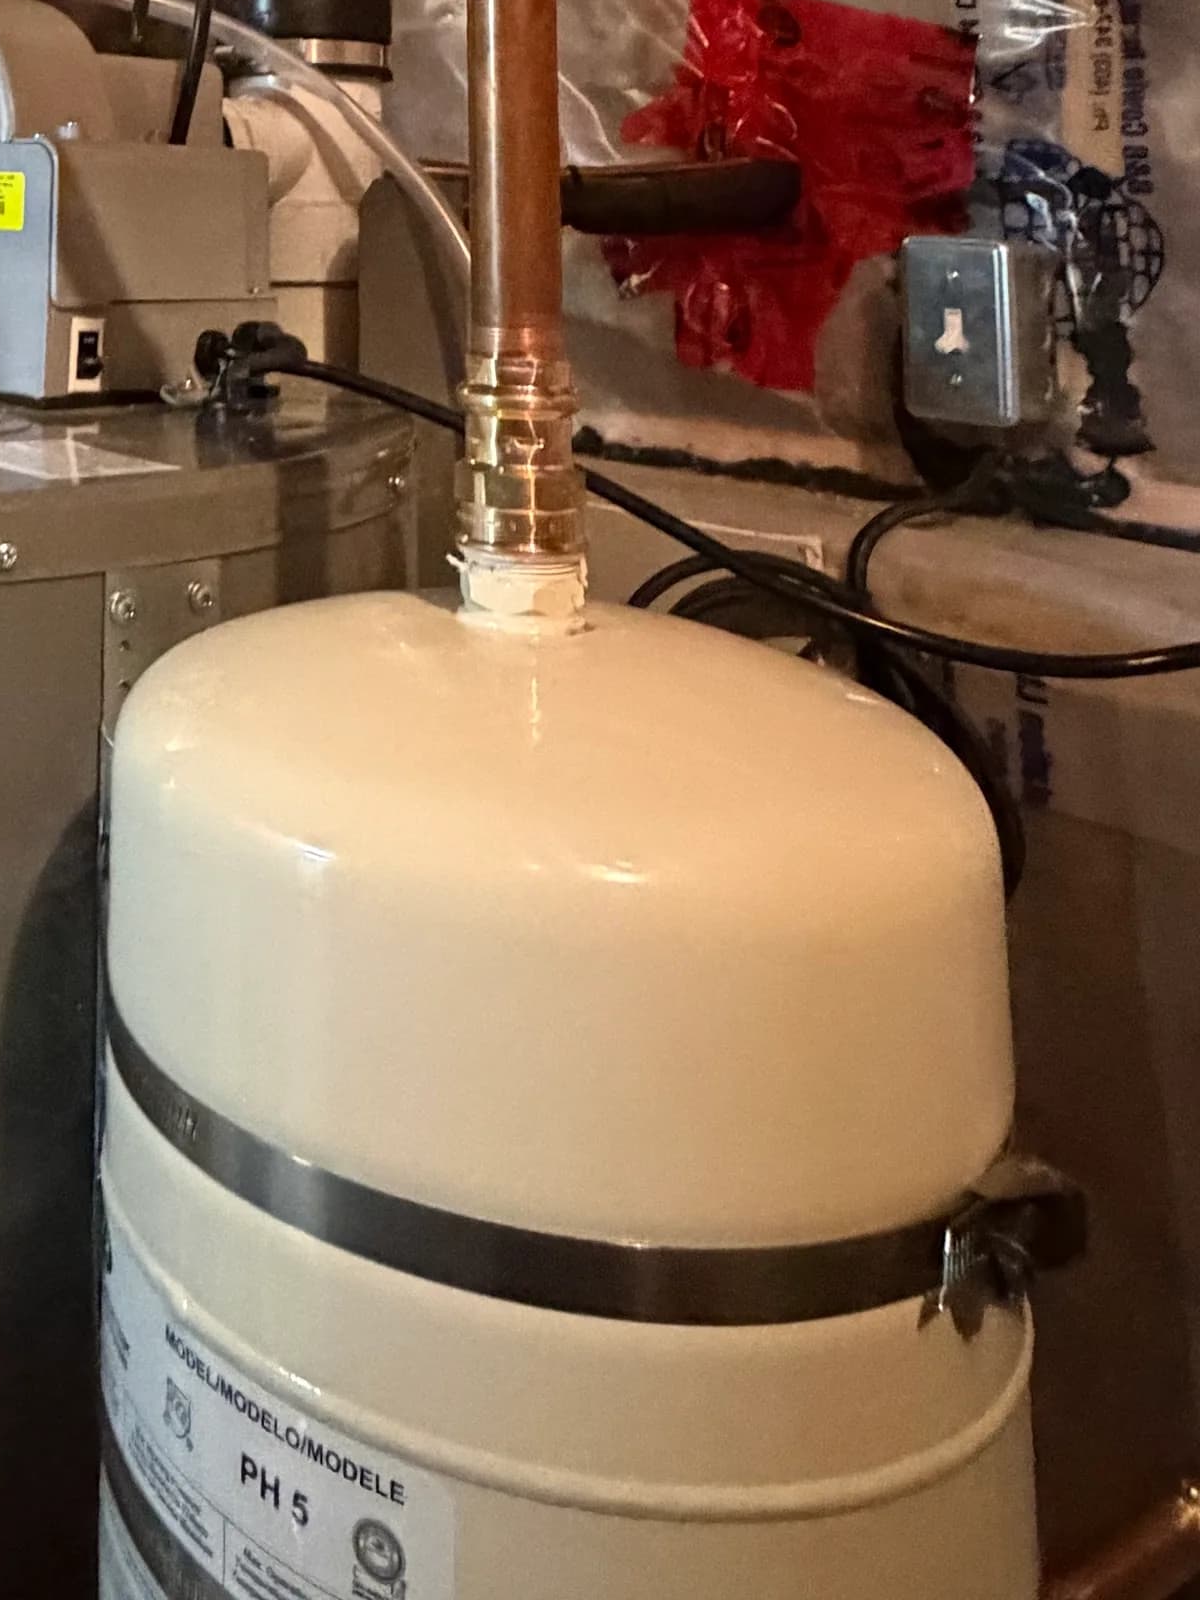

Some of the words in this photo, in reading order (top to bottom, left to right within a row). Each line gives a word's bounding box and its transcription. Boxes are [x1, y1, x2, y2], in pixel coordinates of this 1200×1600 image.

[165, 1325, 407, 1506] MODEL/MODELO/MODELE
[240, 1451, 281, 1510] PH
[291, 1489, 310, 1527] 5
